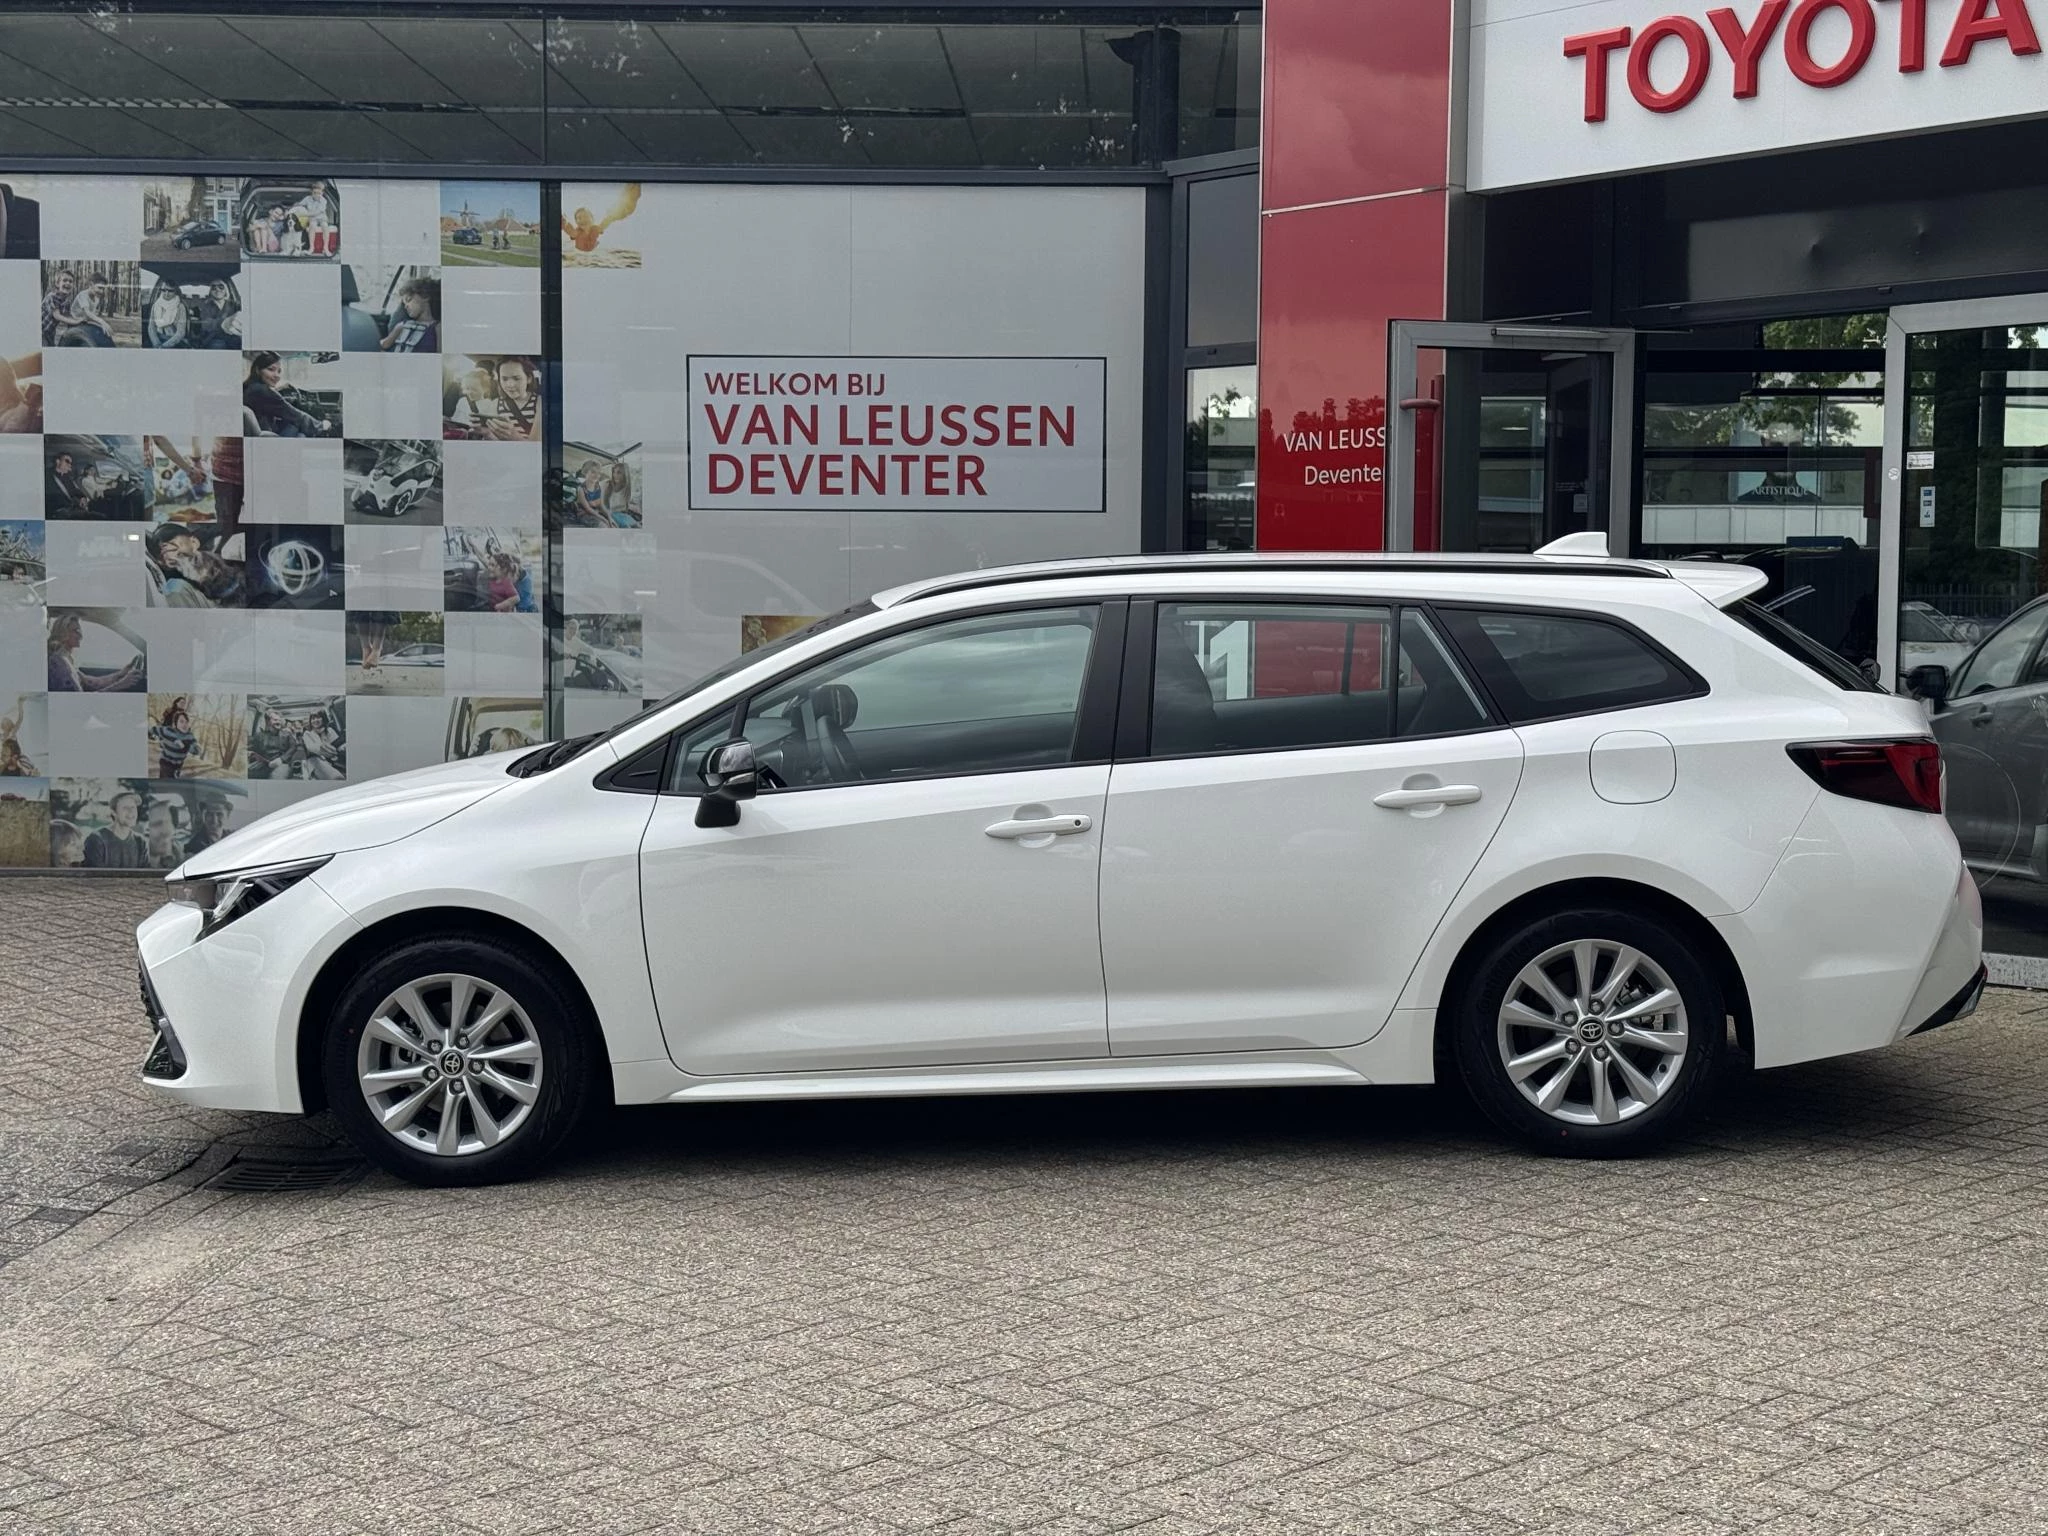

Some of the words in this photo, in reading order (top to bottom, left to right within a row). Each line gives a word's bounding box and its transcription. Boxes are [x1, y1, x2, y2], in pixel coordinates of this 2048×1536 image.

[1563, 0, 2042, 123] TOYOTA
[704, 372, 838, 395] WELKOM
[847, 373, 886, 396] BIJ
[704, 404, 819, 446] VAN
[838, 404, 1075, 447] LEUSSEN
[1283, 430, 1322, 452] VAN
[708, 453, 988, 496] DEVENTER
[1304, 464, 1385, 486] Devente
[1752, 486, 1808, 497] ARTISTIQUE
